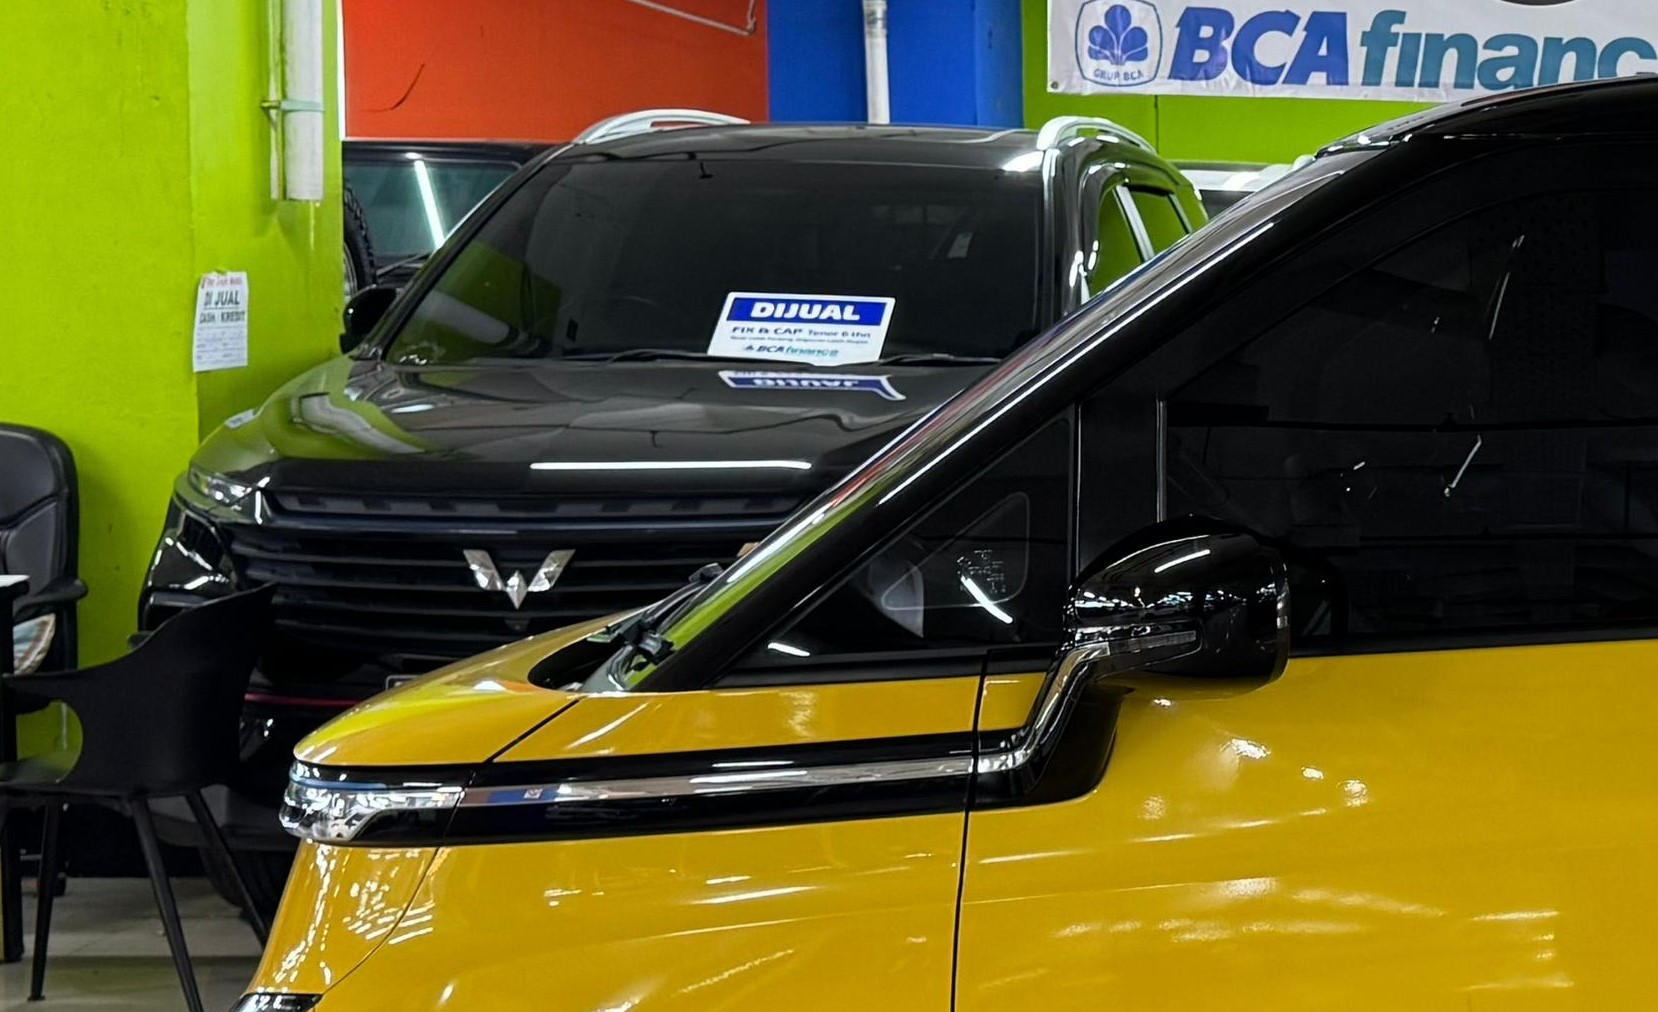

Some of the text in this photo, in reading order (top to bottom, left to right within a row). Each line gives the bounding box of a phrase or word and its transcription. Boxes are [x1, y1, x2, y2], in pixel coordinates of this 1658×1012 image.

[1168, 7, 1349, 86] BCA
[214, 289, 241, 306] JUAL
[751, 302, 861, 321] DIJUAL
